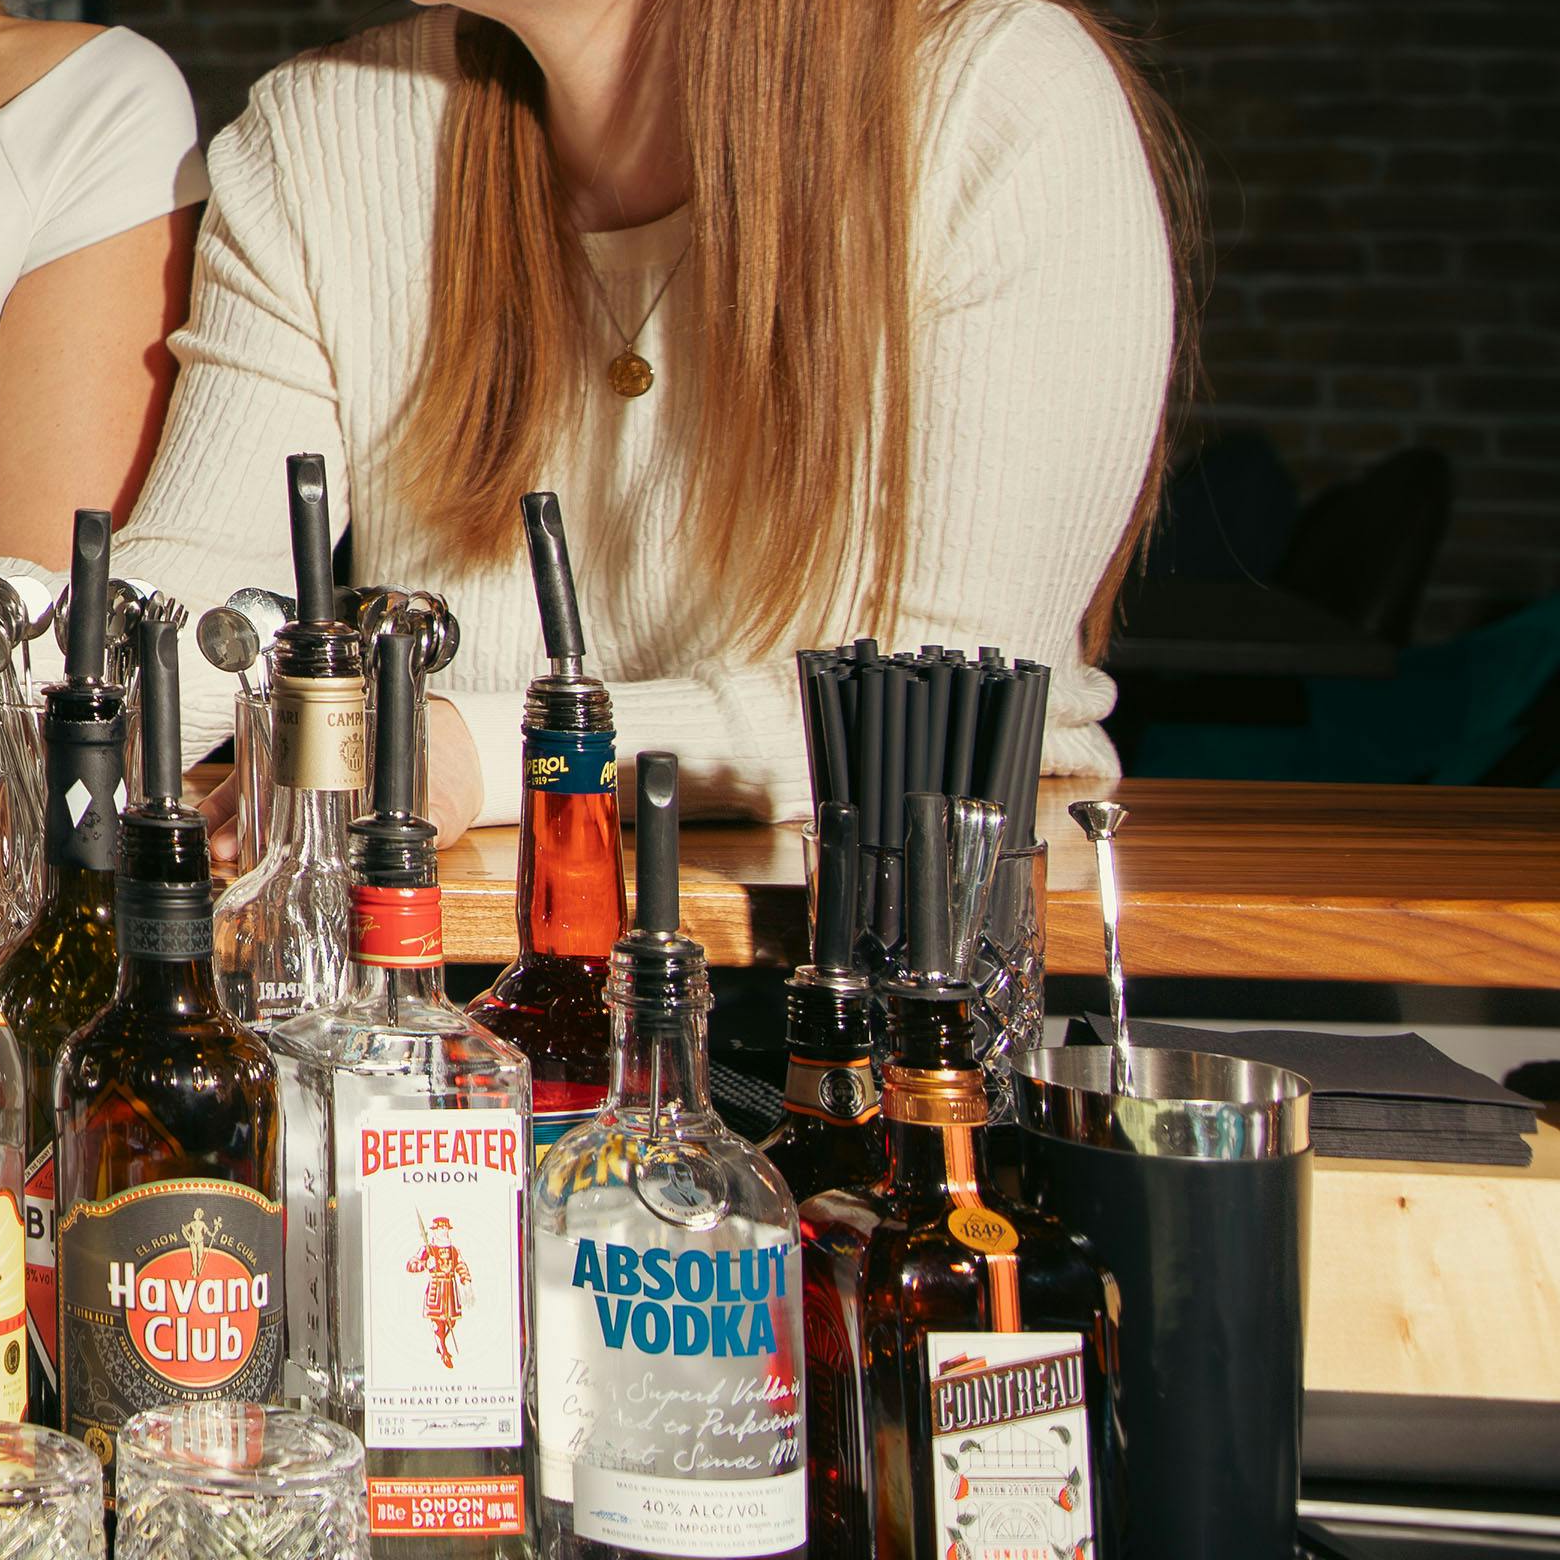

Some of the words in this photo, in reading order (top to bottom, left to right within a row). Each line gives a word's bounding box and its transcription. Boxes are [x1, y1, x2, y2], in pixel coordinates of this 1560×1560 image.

[527, 756, 569, 775] PEROL
[361, 1127, 517, 1177] BEEFEATER
[403, 1170, 479, 1183] LONDON
[959, 1219, 1003, 1241] 1849
[135, 1246, 151, 1257] EL
[151, 1232, 178, 1249] RON
[220, 1233, 235, 1247] DE
[237, 1242, 258, 1267] CUBA
[572, 1238, 788, 1304] ABSOLUT
[107, 1261, 270, 1314] Havana
[594, 1295, 777, 1358] VODKA
[145, 1316, 243, 1362] Club
[373, 1397, 394, 1405] THE
[401, 1397, 440, 1405] HEART
[445, 1397, 459, 1405] OF
[465, 1396, 514, 1404] LONDON
[627, 1372, 726, 1411] Superb
[732, 1375, 791, 1407] Vodka
[939, 1355, 1082, 1431] COINTREAU
[664, 1419, 691, 1435] to
[673, 1443, 763, 1473] Since
[375, 1485, 392, 1493] THE
[394, 1484, 430, 1494] WORLD'S
[434, 1484, 456, 1493] MOST
[458, 1483, 498, 1493] AWARDED
[500, 1483, 516, 1493] GIN
[973, 1486, 1006, 1495] MAISON
[412, 1498, 483, 1513] LONDON
[690, 1500, 768, 1518] ALC/VOL
[412, 1513, 446, 1527] DRY
[453, 1512, 483, 1526] GIN
[674, 1522, 742, 1535] IMPORTED
